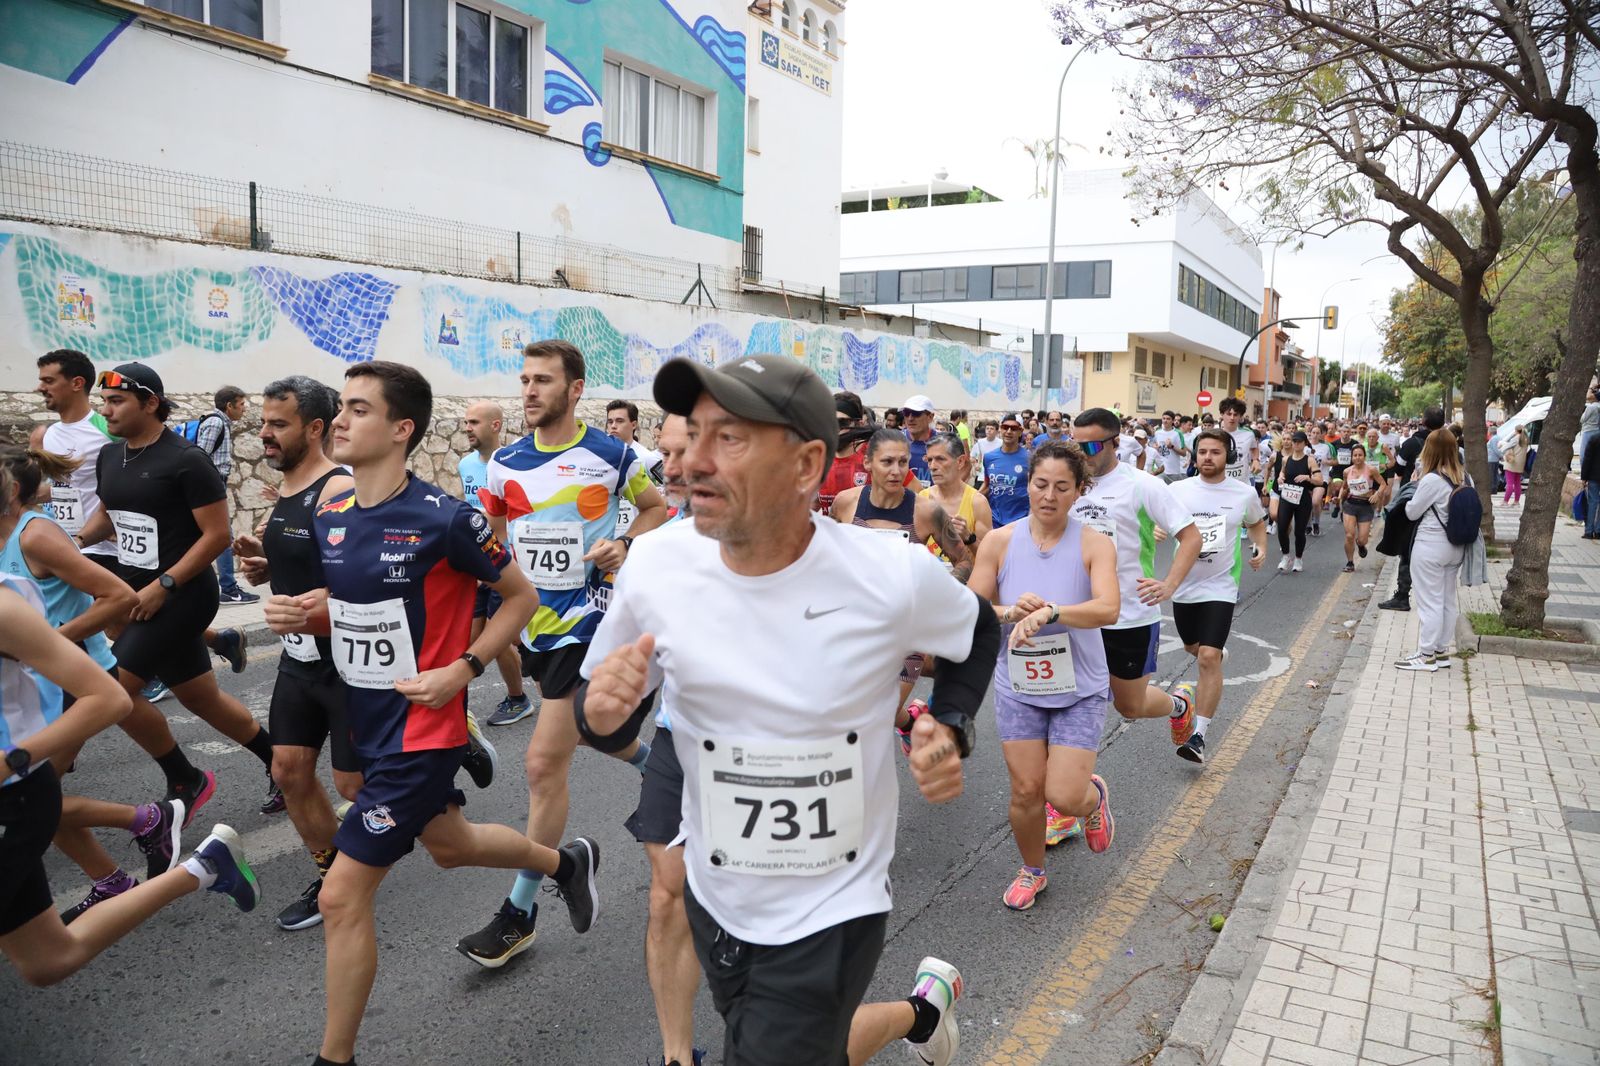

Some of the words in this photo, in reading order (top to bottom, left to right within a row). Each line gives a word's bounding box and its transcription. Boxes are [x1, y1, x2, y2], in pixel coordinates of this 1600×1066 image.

[781, 60, 802, 78] SAFA
[812, 74, 830, 92] ICET
[208, 310, 229, 318] SAFA
[990, 473, 1018, 486] RCM
[1227, 470, 1242, 478] 702
[122, 532, 146, 554] 825
[380, 552, 406, 562] Mobil
[526, 549, 570, 572] 749
[342, 636, 396, 667] 779
[1025, 660, 1054, 680] 53
[734, 797, 836, 841] 731
[744, 861, 785, 870] CARRERA
[787, 861, 828, 870] POPULAR
[828, 857, 837, 865] EL
